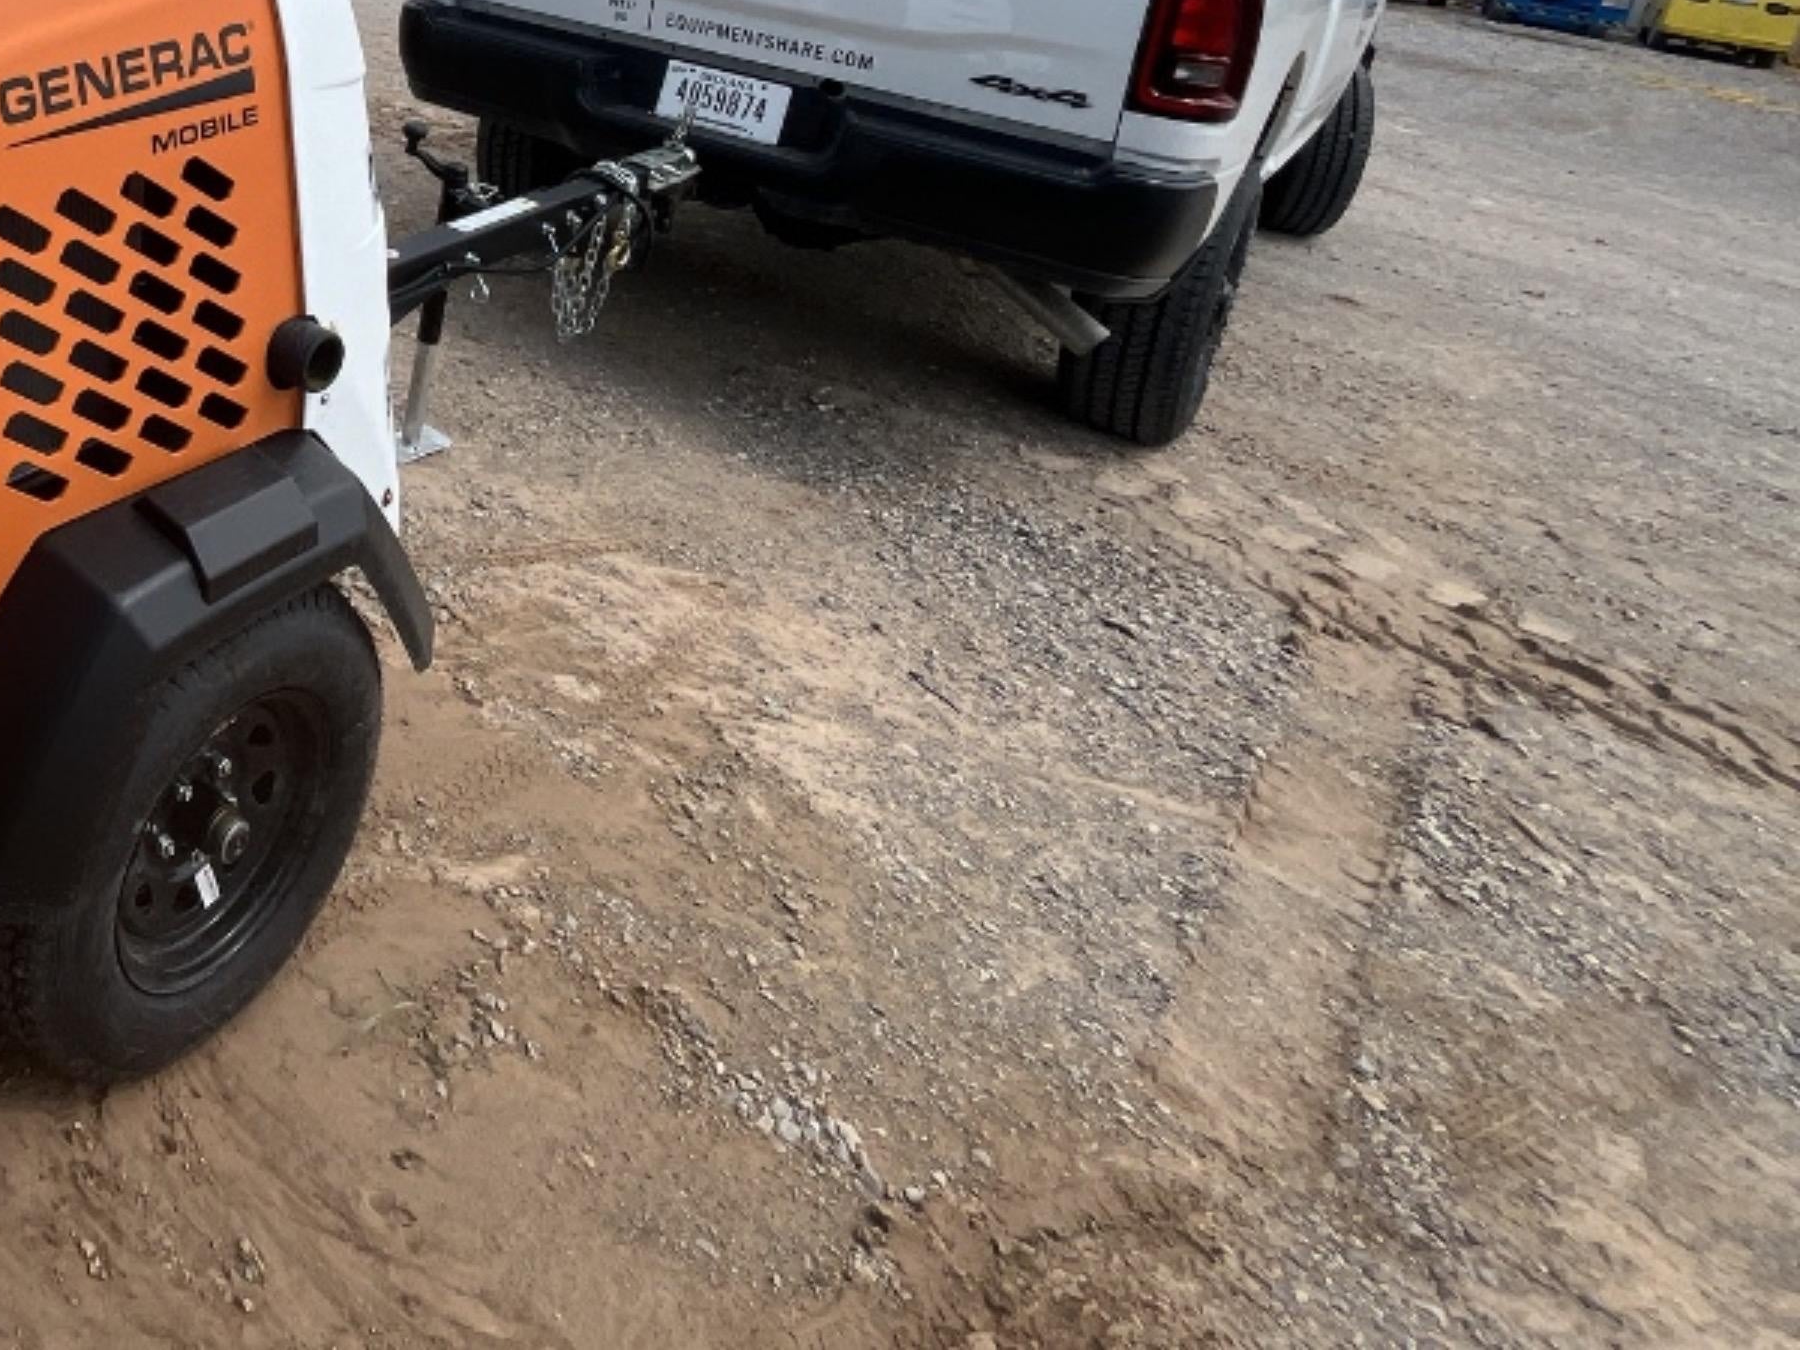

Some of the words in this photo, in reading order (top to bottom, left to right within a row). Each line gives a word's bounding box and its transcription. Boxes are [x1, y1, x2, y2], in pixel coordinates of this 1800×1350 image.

[664, 11, 875, 72] EQUIPMENTSHARE.COM
[968, 74, 1092, 109] 4x4
[151, 105, 259, 154] MOBILE
